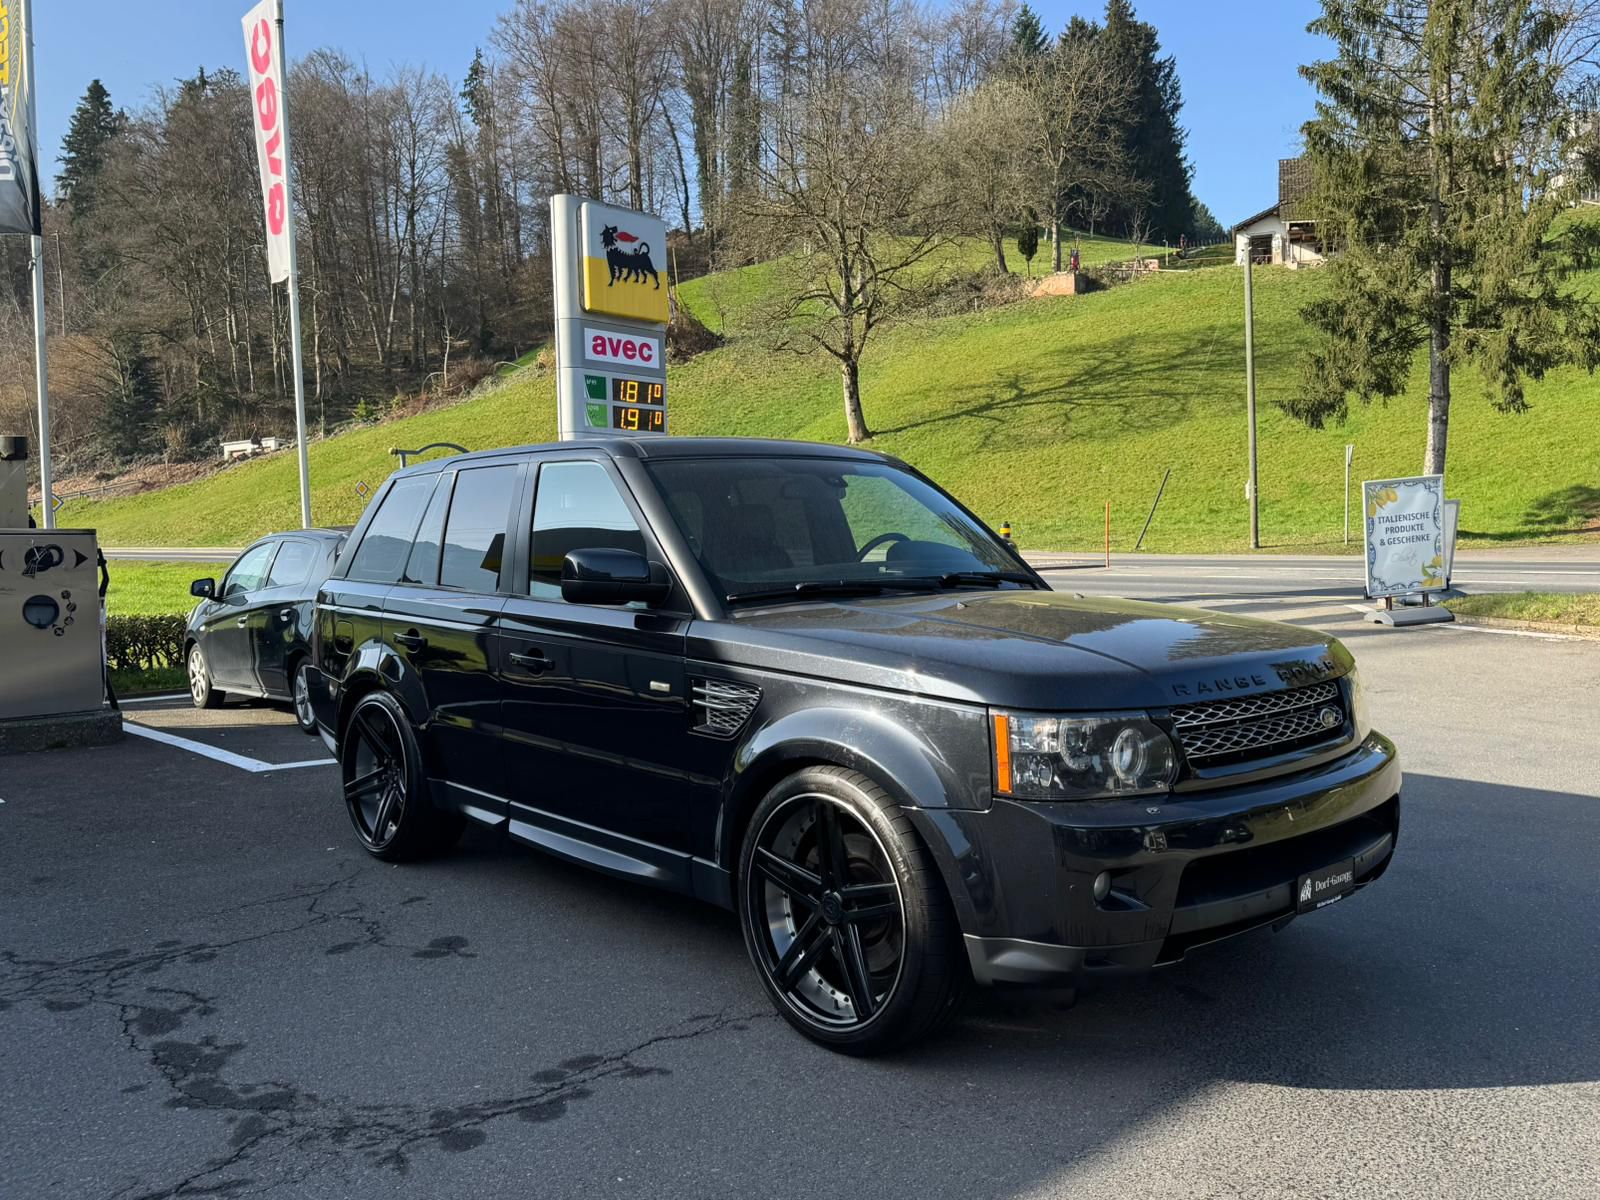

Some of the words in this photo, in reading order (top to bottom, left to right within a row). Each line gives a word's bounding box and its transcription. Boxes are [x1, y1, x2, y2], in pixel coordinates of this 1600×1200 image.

[592, 335, 653, 362] avec
[1378, 511, 1430, 524] ITALIENISCHE
[1385, 523, 1425, 535] PRODUKTE
[1379, 538, 1387, 546] &
[1387, 534, 1431, 546] GESCHENKE
[1172, 674, 1267, 697] RANGE
[1276, 659, 1335, 682] ROVER
